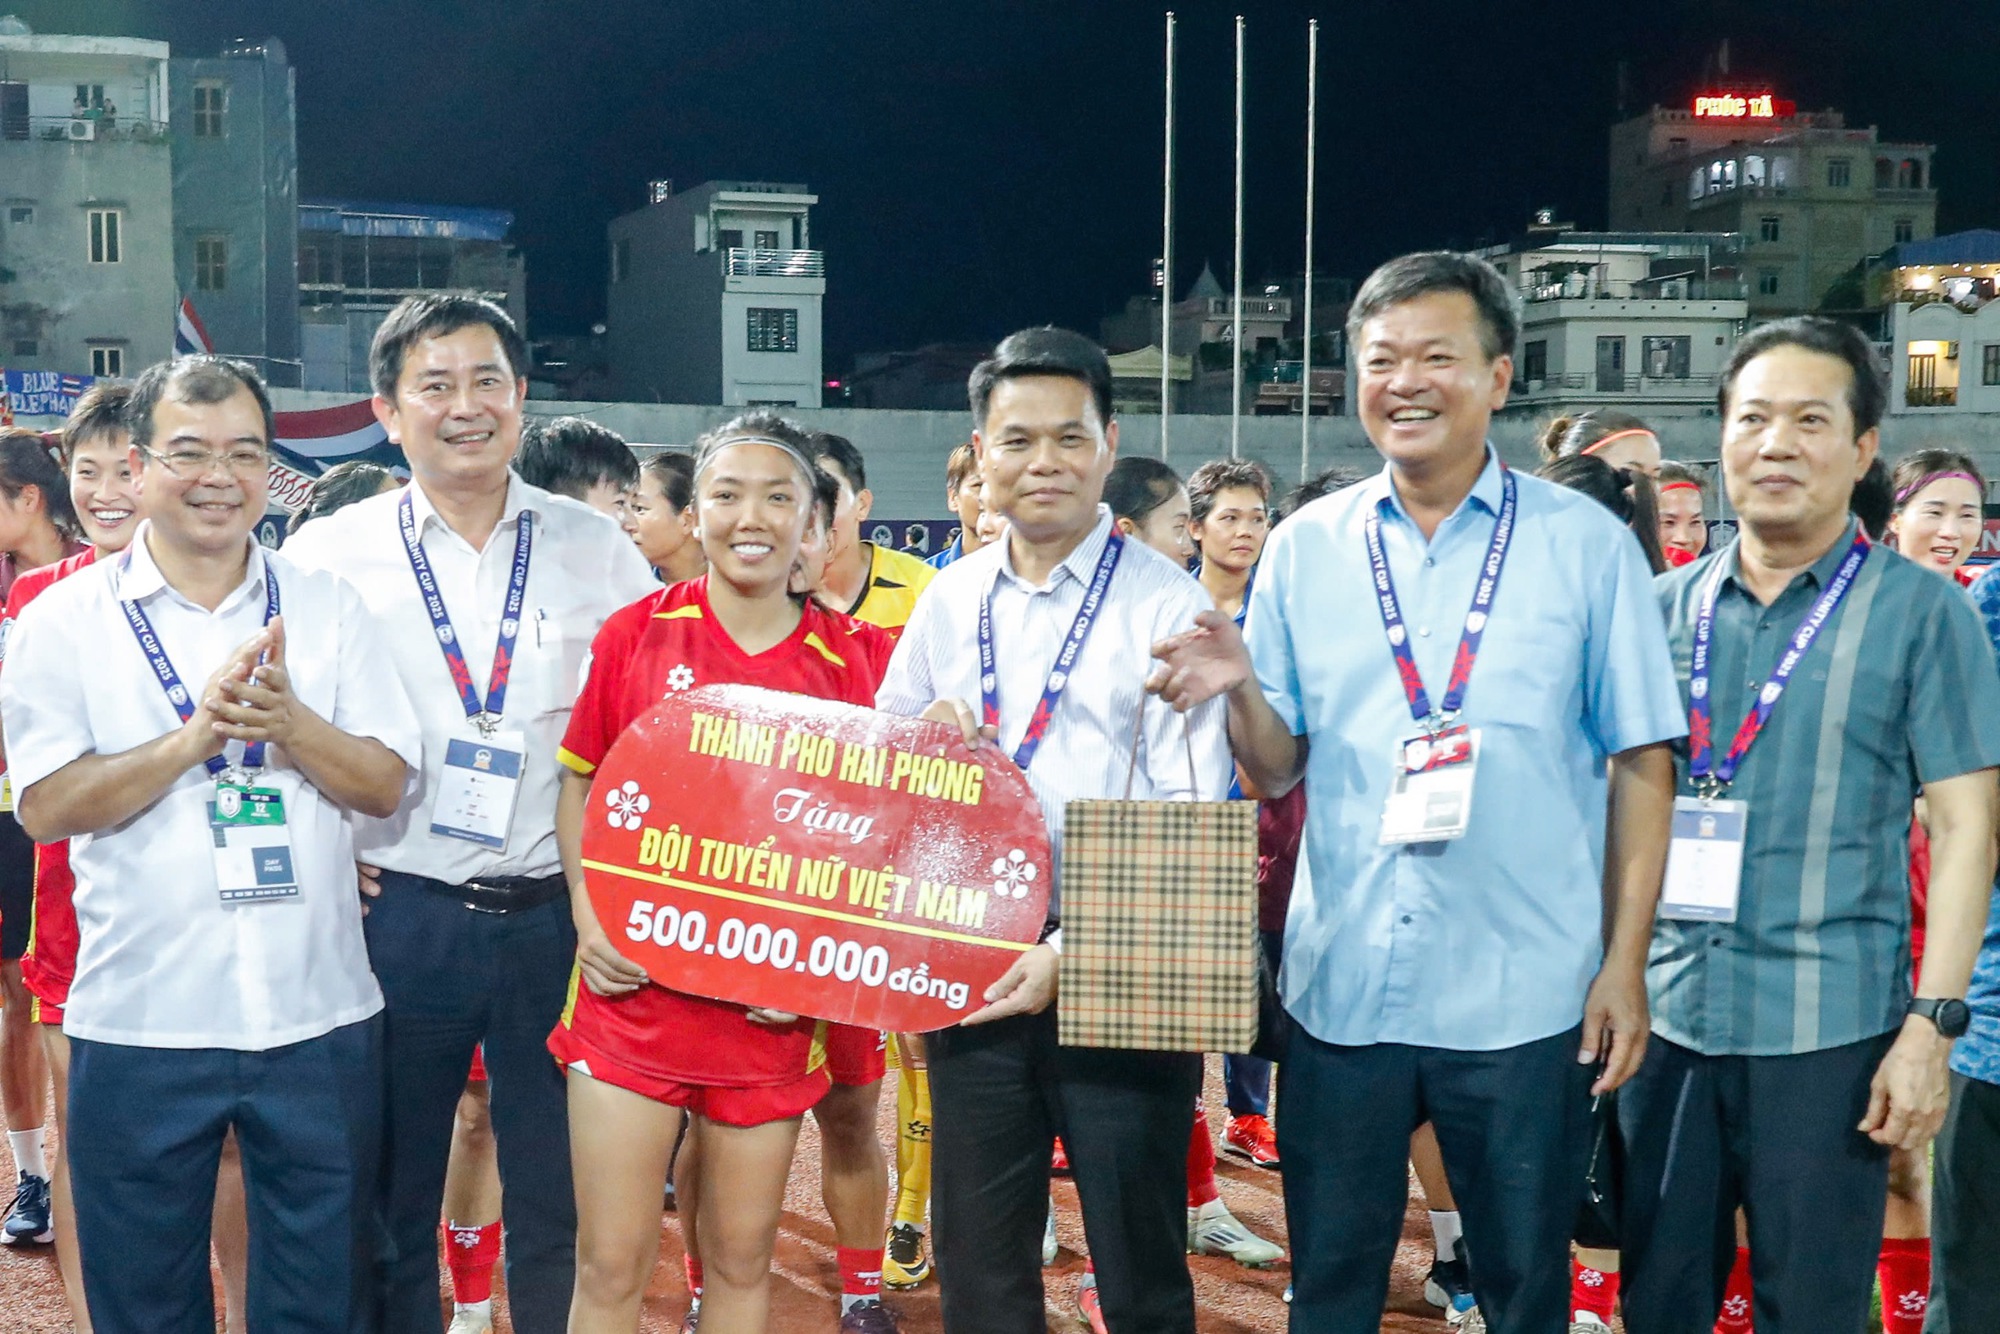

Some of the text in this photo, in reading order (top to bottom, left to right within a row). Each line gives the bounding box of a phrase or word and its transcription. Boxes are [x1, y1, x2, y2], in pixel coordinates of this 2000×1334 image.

[1695, 93, 1747, 117] PHÚC
[22, 372, 60, 394] BLUE
[1492, 500, 1515, 552] SERENITY
[516, 520, 530, 567] SERENITY
[403, 527, 428, 571] SERENITY
[419, 571, 435, 594] CUP
[427, 594, 445, 620] 2025
[514, 566, 527, 587] CUP
[1485, 552, 1502, 577] CUP
[1082, 567, 1110, 617] SERENITY
[1375, 569, 1390, 591] CUP
[1476, 577, 1496, 606] 2025
[508, 588, 521, 613] 2025
[1380, 592, 1398, 621] 2025
[1808, 577, 1847, 628] SERENITY
[980, 617, 991, 640] CUP
[1074, 616, 1090, 640] CUP
[1697, 619, 1710, 642] CUP
[1796, 625, 1816, 650] CUP
[142, 633, 160, 655] CUP
[153, 655, 174, 681] 2025
[981, 641, 993, 668] 2025
[1060, 641, 1079, 667] 2025
[1693, 644, 1708, 671] 2025
[1777, 650, 1800, 678] 2025
[688, 710, 777, 767] THÀNH
[889, 747, 985, 806] PHÒNG
[254, 803, 267, 813] 12
[773, 788, 874, 844] Tặng
[638, 823, 989, 929] ĐỘI TUYỂN NỮ VIỆT NAM
[625, 899, 970, 1010] 500.000.000 đồng
